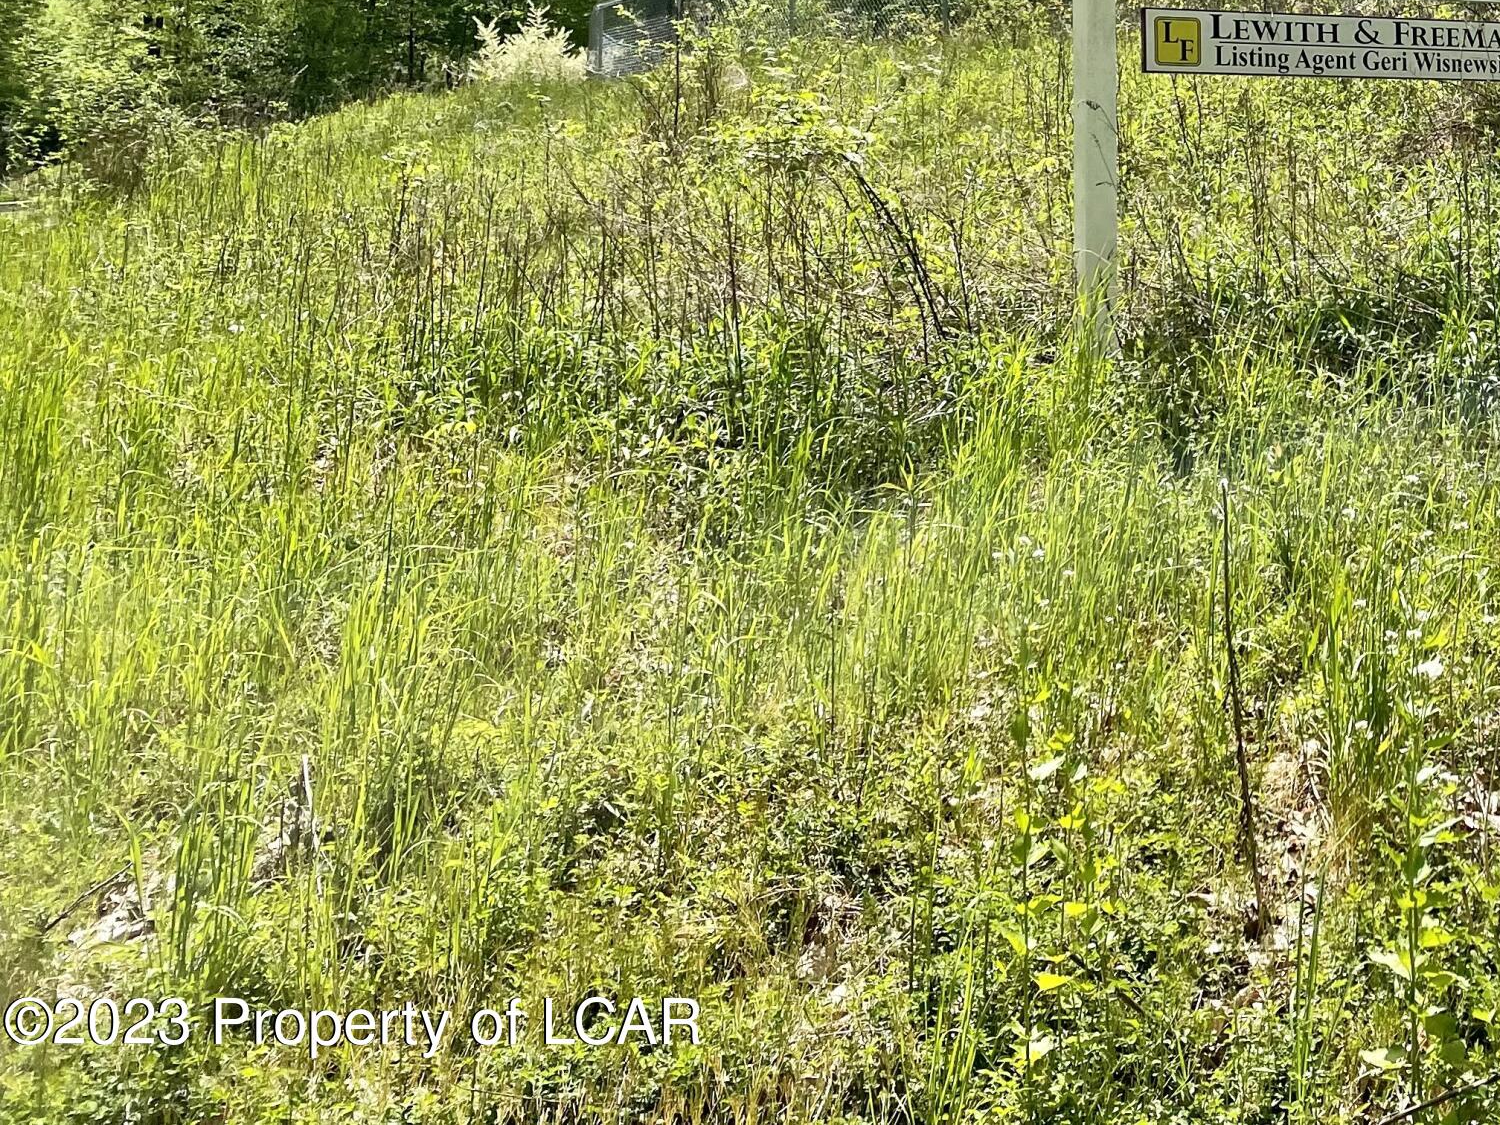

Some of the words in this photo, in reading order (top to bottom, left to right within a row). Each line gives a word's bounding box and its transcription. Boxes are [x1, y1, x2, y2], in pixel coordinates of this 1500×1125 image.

[1209, 13, 1340, 44] LEWITH
[1354, 19, 1384, 45] &
[1215, 45, 1289, 74] Listing
[1295, 49, 1356, 74] Agent
[1362, 50, 1407, 71] Geri
